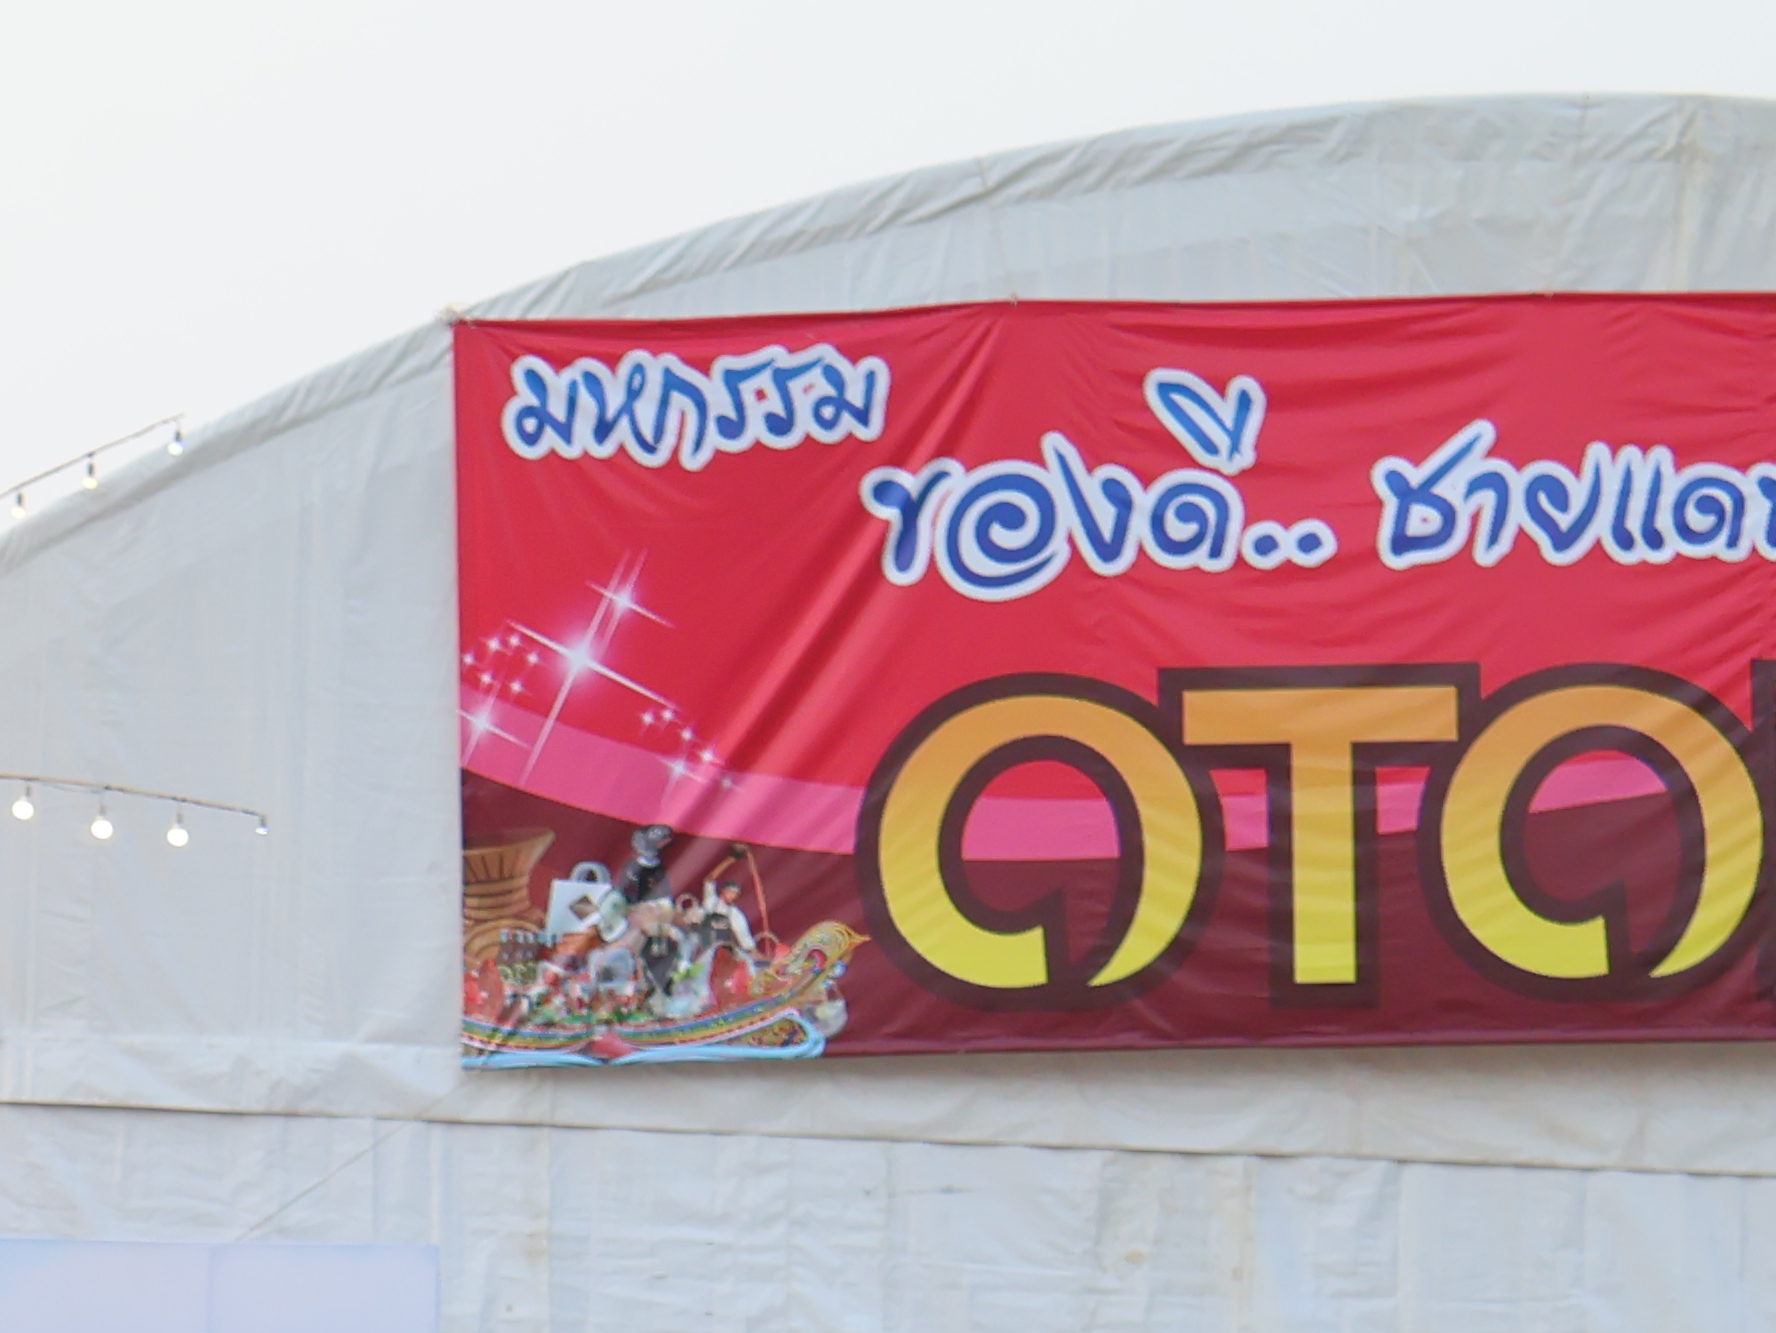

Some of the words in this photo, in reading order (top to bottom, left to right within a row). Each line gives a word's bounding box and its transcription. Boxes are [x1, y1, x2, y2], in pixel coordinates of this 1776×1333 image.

[508, 346, 885, 466] มหกรรม
[872, 680, 1776, 995] OTO
